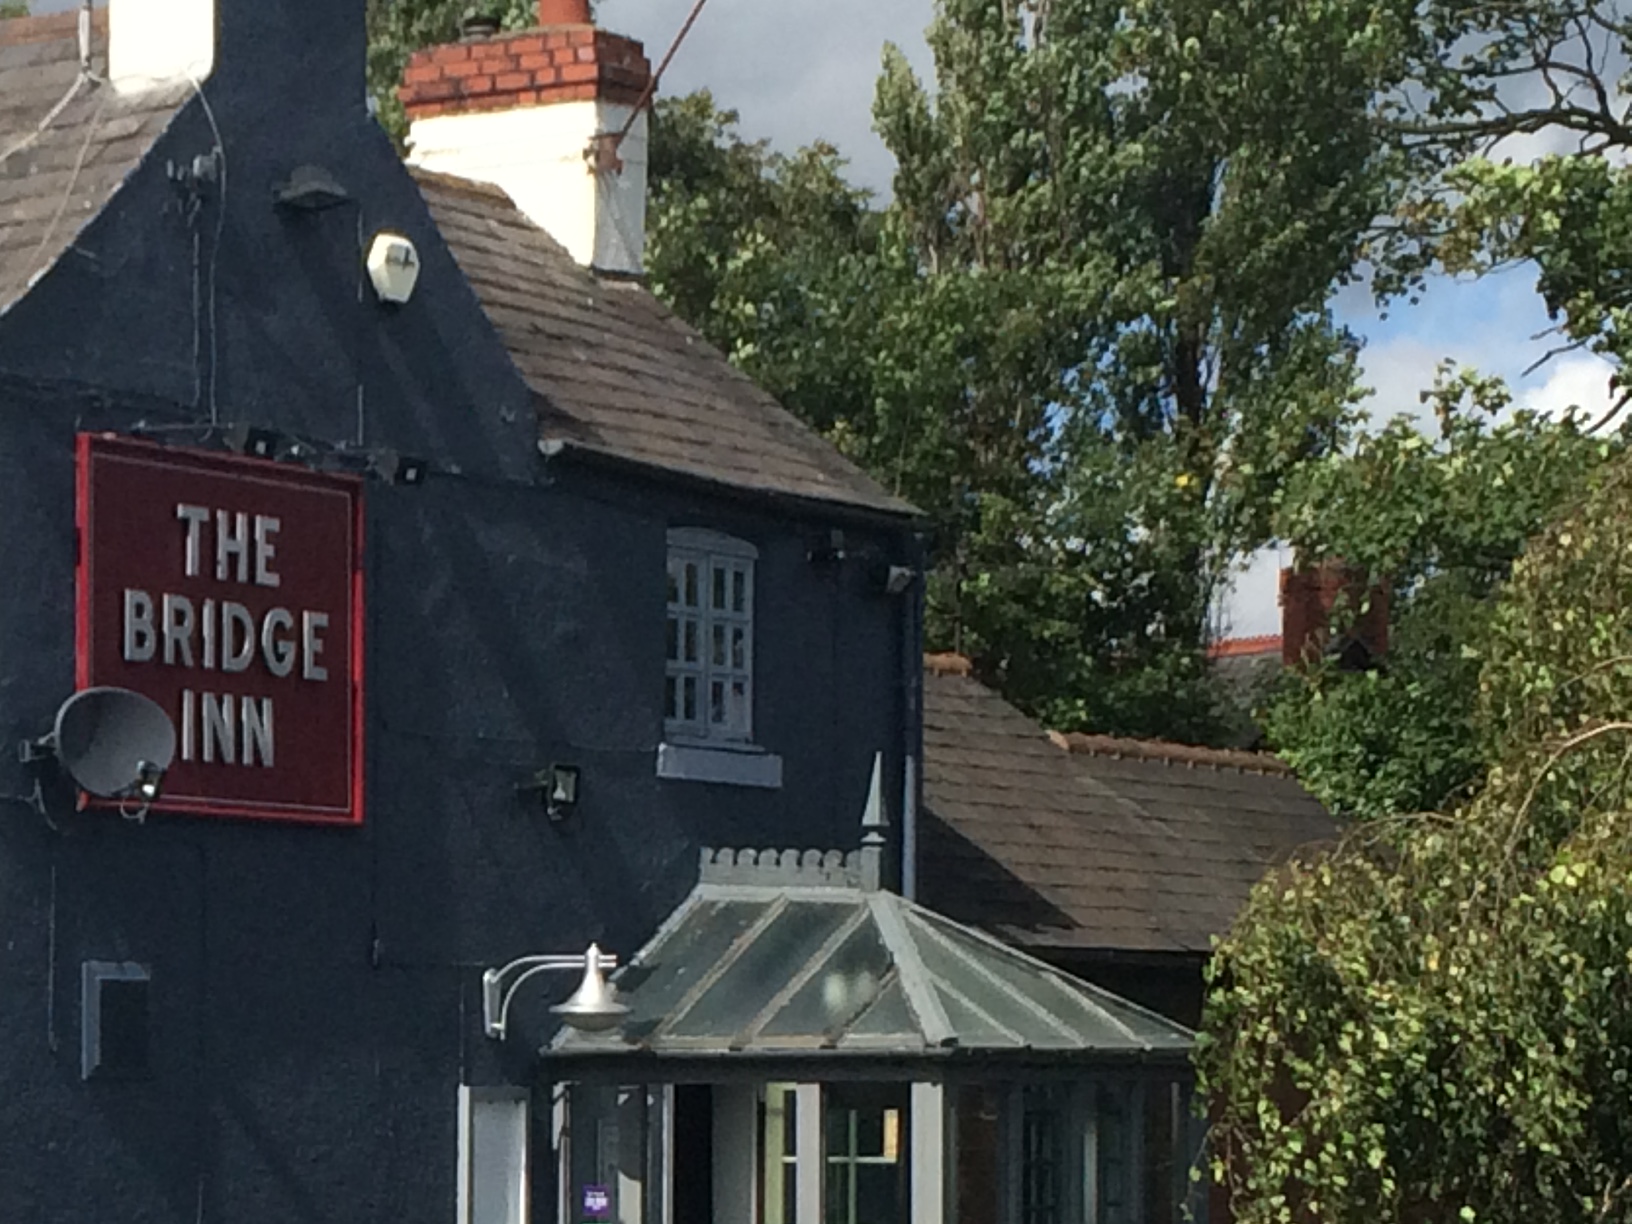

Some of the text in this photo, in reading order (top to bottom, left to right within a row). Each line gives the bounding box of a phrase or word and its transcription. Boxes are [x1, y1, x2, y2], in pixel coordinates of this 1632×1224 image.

[177, 503, 280, 587] THE
[124, 588, 328, 681] BRIDGE
[182, 689, 274, 767] INN
